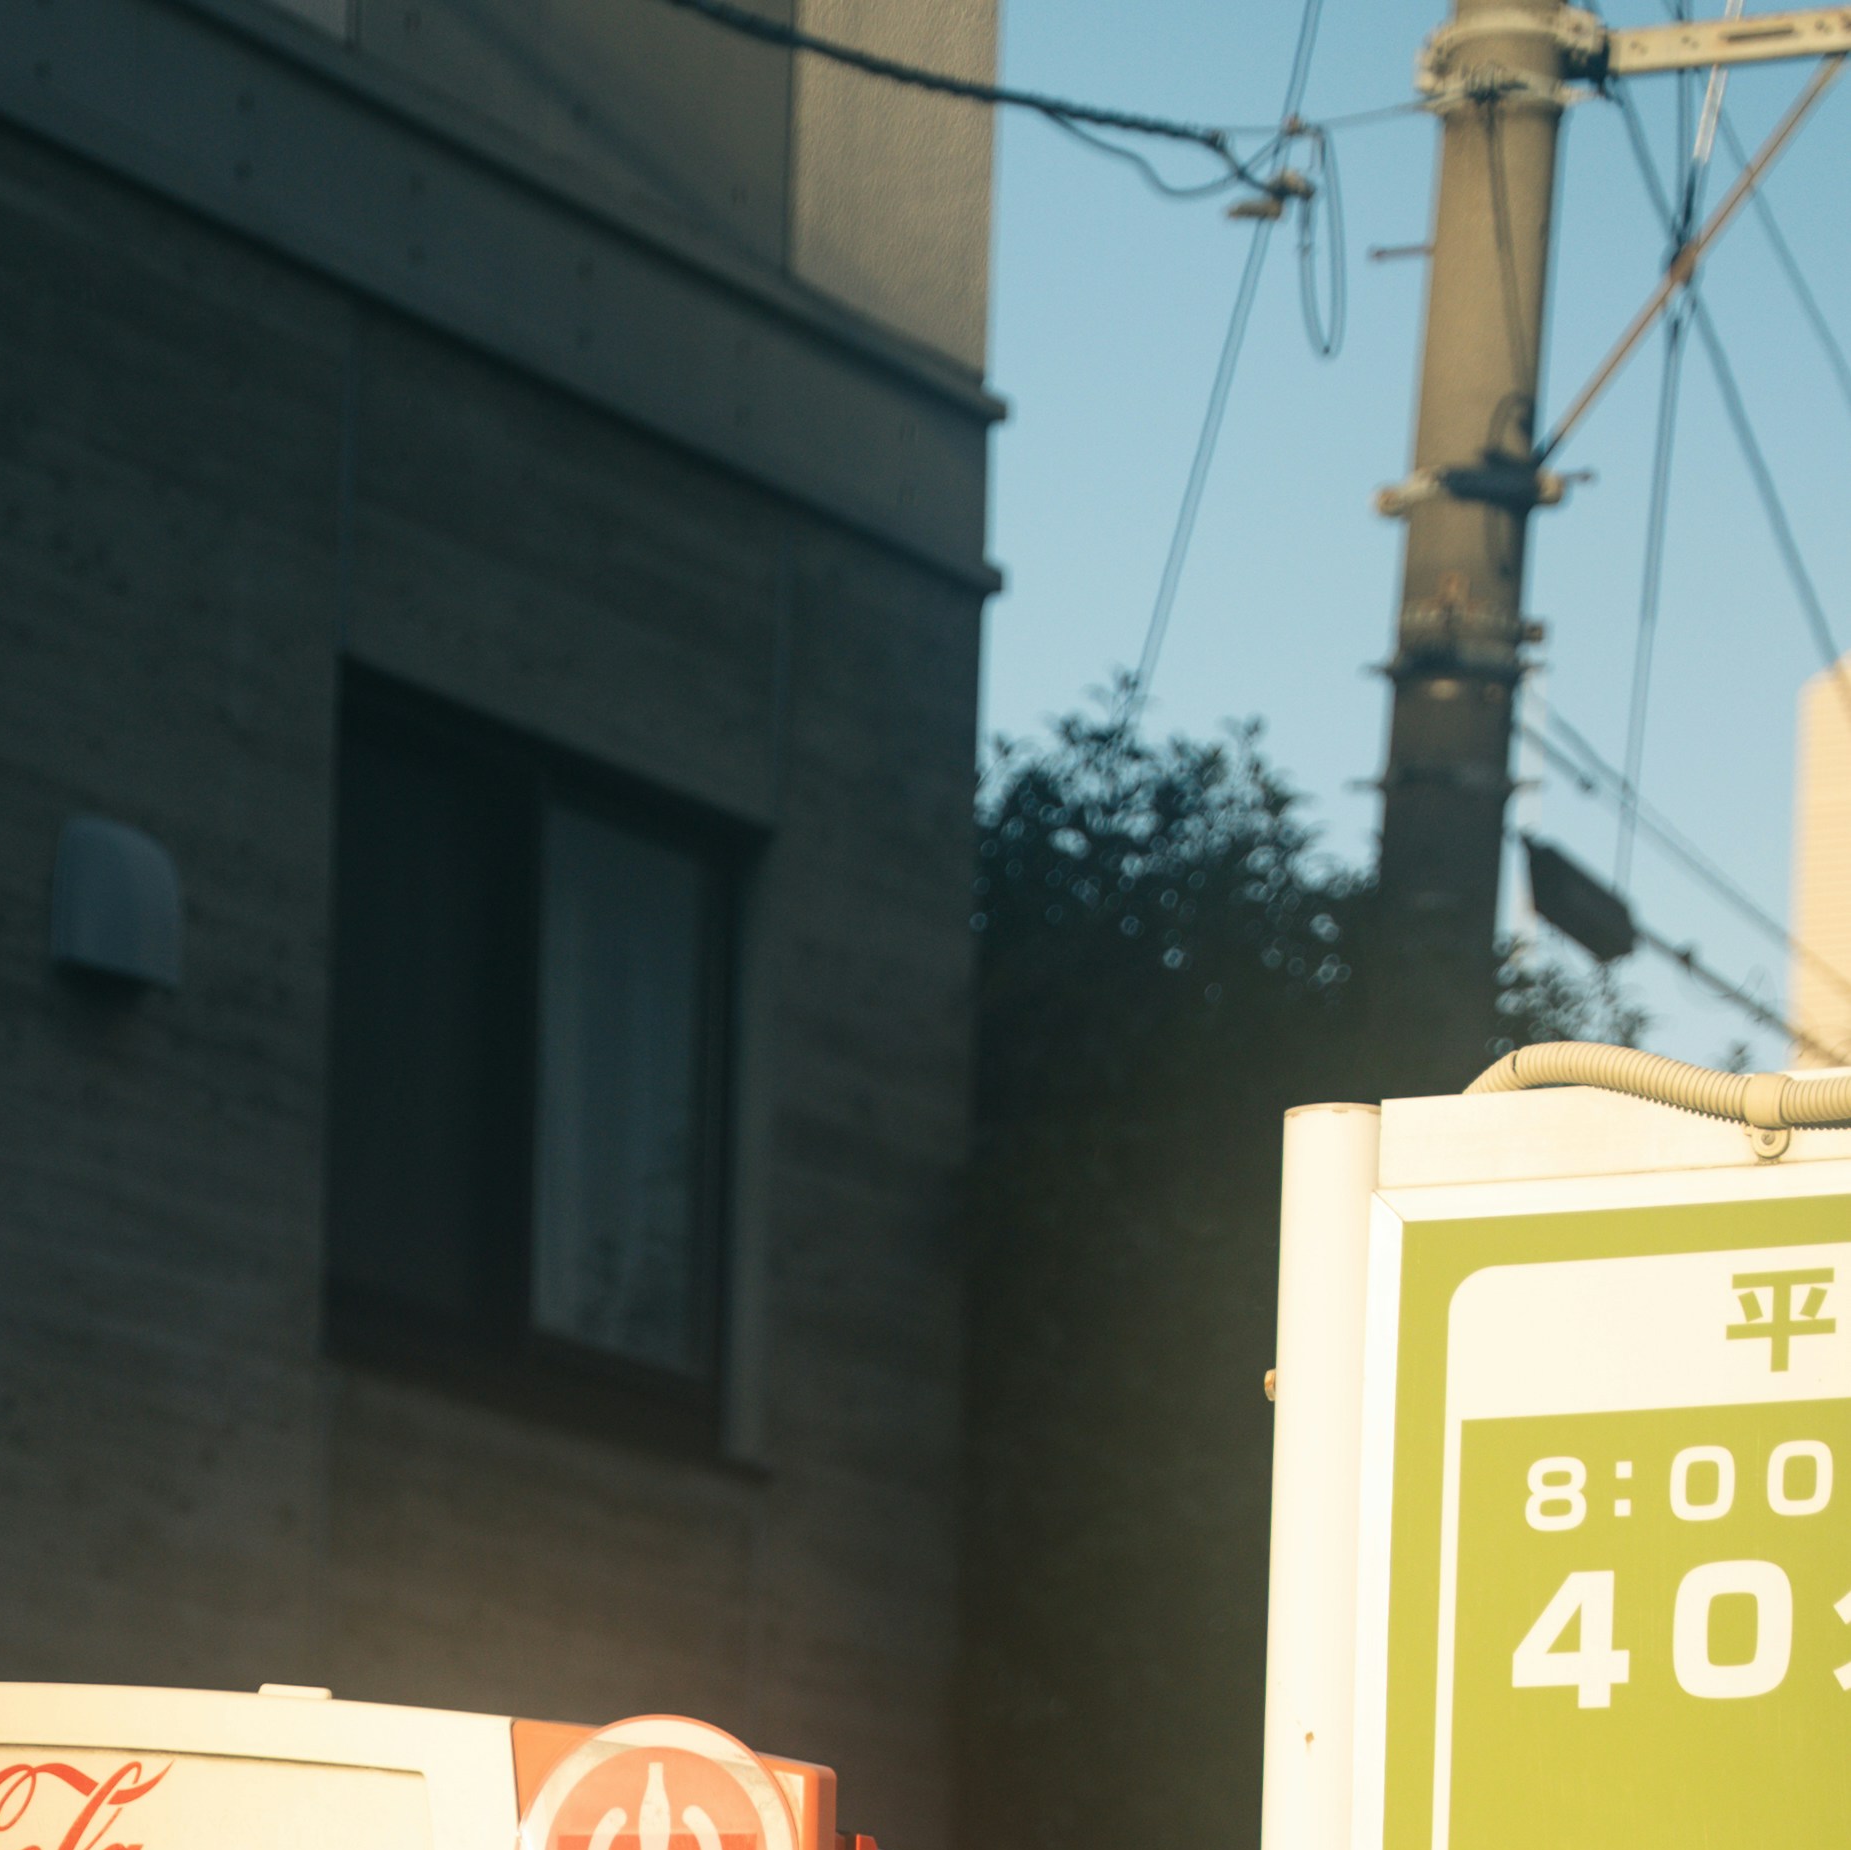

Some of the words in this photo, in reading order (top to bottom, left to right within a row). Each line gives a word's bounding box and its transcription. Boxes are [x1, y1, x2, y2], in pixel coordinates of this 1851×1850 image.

[1726, 1267, 1837, 1372] 平
[1525, 1439, 1833, 1531] 8:00
[1511, 1559, 1851, 1709] 40
